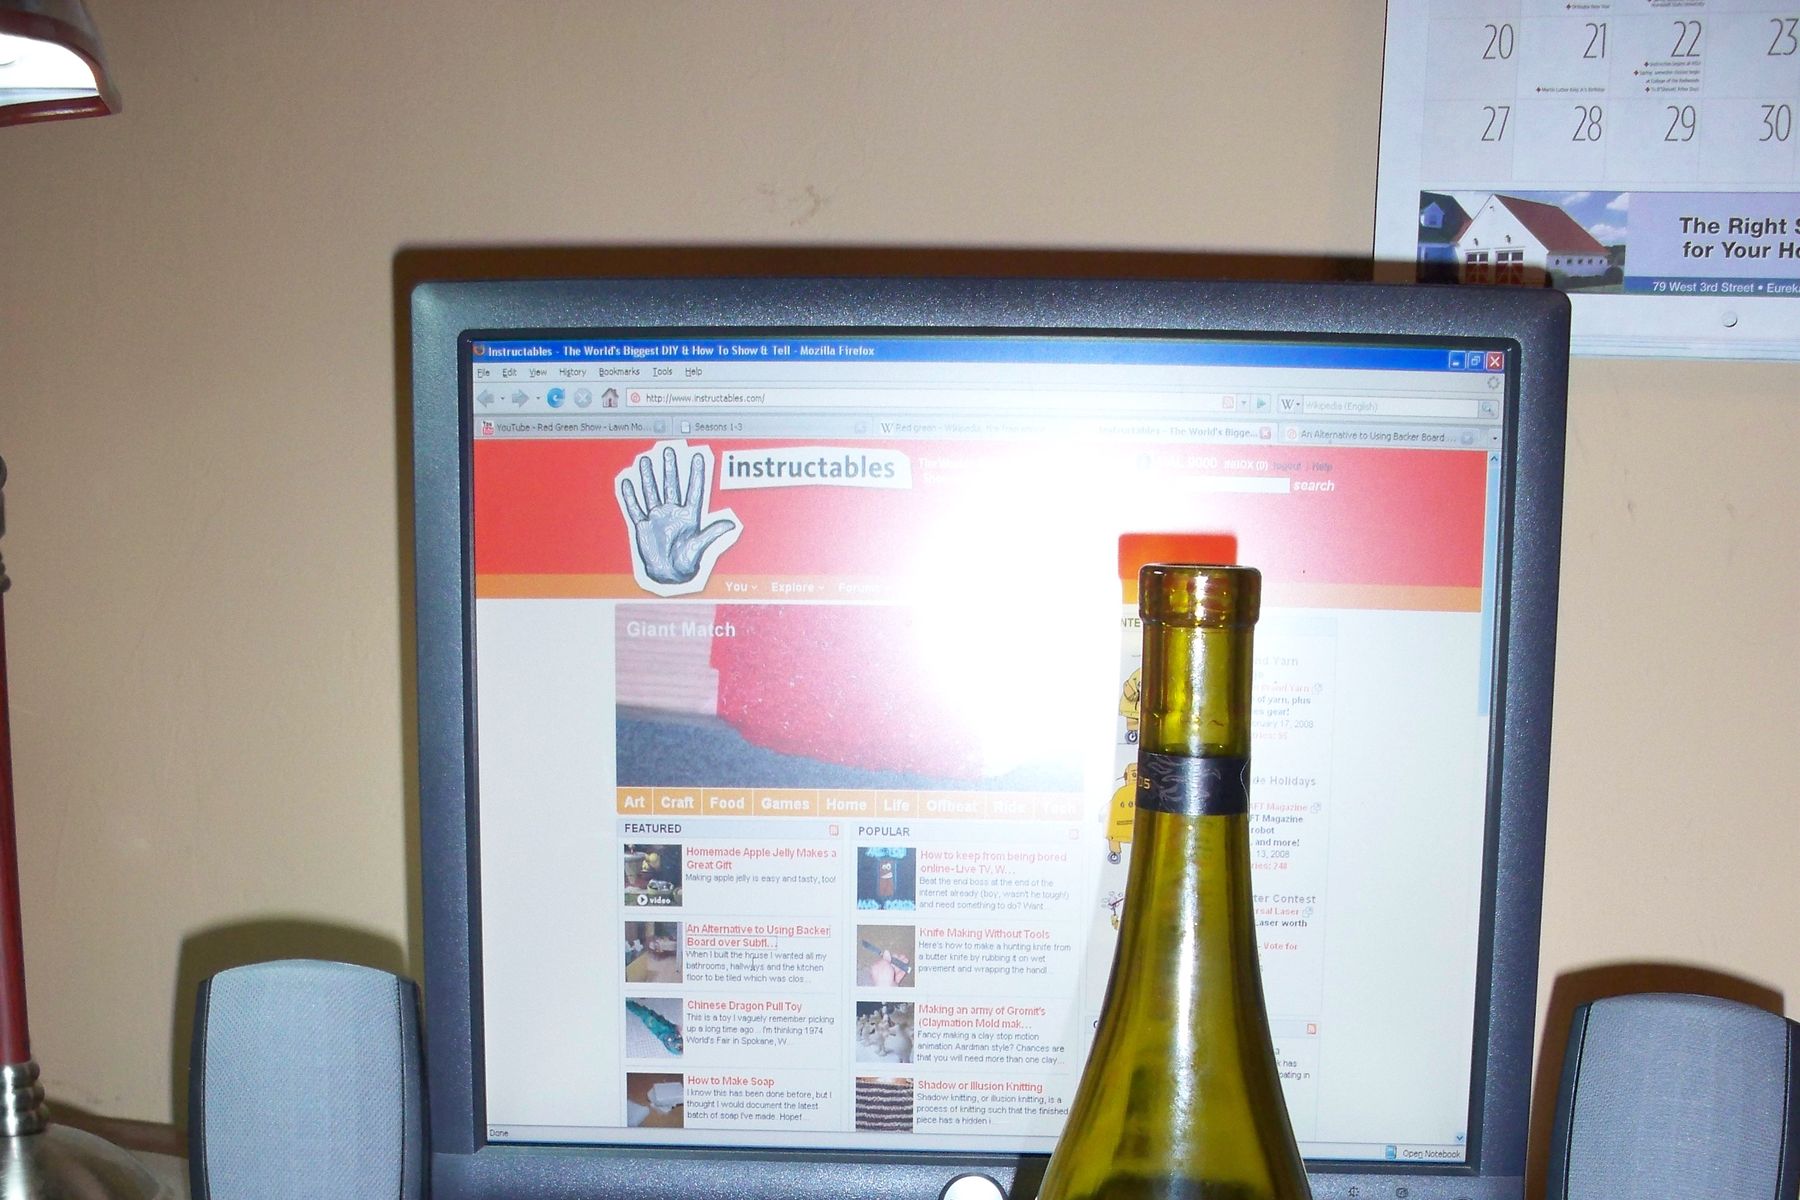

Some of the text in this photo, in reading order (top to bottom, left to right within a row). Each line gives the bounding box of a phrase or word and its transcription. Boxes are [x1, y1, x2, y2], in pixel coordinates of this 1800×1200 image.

[1482, 18, 1799, 59] 20 21 22 23
[1481, 104, 1792, 142] 27 28 29 30
[1679, 217, 1720, 234] The
[1728, 217, 1787, 238] Right
[1682, 241, 1714, 258] for
[1721, 241, 1771, 259] Your
[1652, 281, 1666, 292] 79
[1669, 282, 1696, 292] West
[1700, 282, 1718, 292] 3rd
[1721, 282, 1754, 293] Street
[488, 346, 552, 357] Instructables
[563, 346, 581, 356] The
[583, 345, 621, 356] World's
[623, 345, 659, 358] Biggest
[661, 345, 679, 355] DIY
[692, 345, 713, 356] How
[718, 345, 729, 356] To
[732, 345, 759, 356] Show
[772, 346, 791, 356] Tell
[800, 346, 836, 356] Mozilla
[839, 346, 875, 356] Firefox
[477, 367, 702, 378] File Edit View History Bookmarks Tools Help
[647, 393, 765, 404] http://www.instructables.com/
[497, 423, 530, 432] YouTube
[538, 423, 553, 432] Red
[555, 423, 578, 432] Green
[580, 423, 602, 432] Show
[609, 423, 629, 432] Lawn
[695, 422, 743, 431] Seasons 1-3
[1301, 430, 1445, 443] An Alternative to Using Backer Board
[728, 454, 895, 479] instructables
[1293, 480, 1335, 491] search
[725, 582, 814, 594] You Explore
[627, 621, 736, 637] Giant Match
[1270, 775, 1316, 788] Holidays
[624, 796, 645, 808] Art
[661, 797, 694, 809] Craft
[710, 797, 745, 809] Food
[761, 797, 810, 810] Games
[826, 798, 867, 811] Home
[883, 800, 910, 812] Life
[1262, 815, 1303, 824] Magazine
[624, 824, 682, 834] FEATURED
[858, 826, 911, 837] POPULAR
[1255, 839, 1271, 847] and
[687, 847, 741, 857] Homemade
[743, 848, 771, 859] Apple
[773, 848, 795, 859] Jelly
[797, 848, 830, 858] Makes
[921, 851, 1066, 863] How to keep from being bored
[687, 860, 732, 870] Great Gift
[649, 897, 671, 905] video
[1272, 895, 1316, 904] Contest
[1281, 919, 1308, 928] worth
[687, 925, 830, 937] An Alternative to Using Backer
[919, 928, 1050, 940] Knife Making Without Tools
[687, 938, 716, 947] Board
[719, 939, 740, 947] over
[688, 1001, 802, 1013] Chinese Dragon Pull Toy
[918, 1006, 954, 1017] Making
[970, 1007, 992, 1018] army
[995, 1006, 1005, 1015] of
[975, 1018, 1000, 1028] Mold
[688, 1076, 775, 1088] How to Make Soap
[917, 1080, 957, 1090] Shadow
[1006, 1081, 1043, 1093] Knitting
[489, 1129, 509, 1137] Done
[1402, 1149, 1461, 1160] Open Notebook
